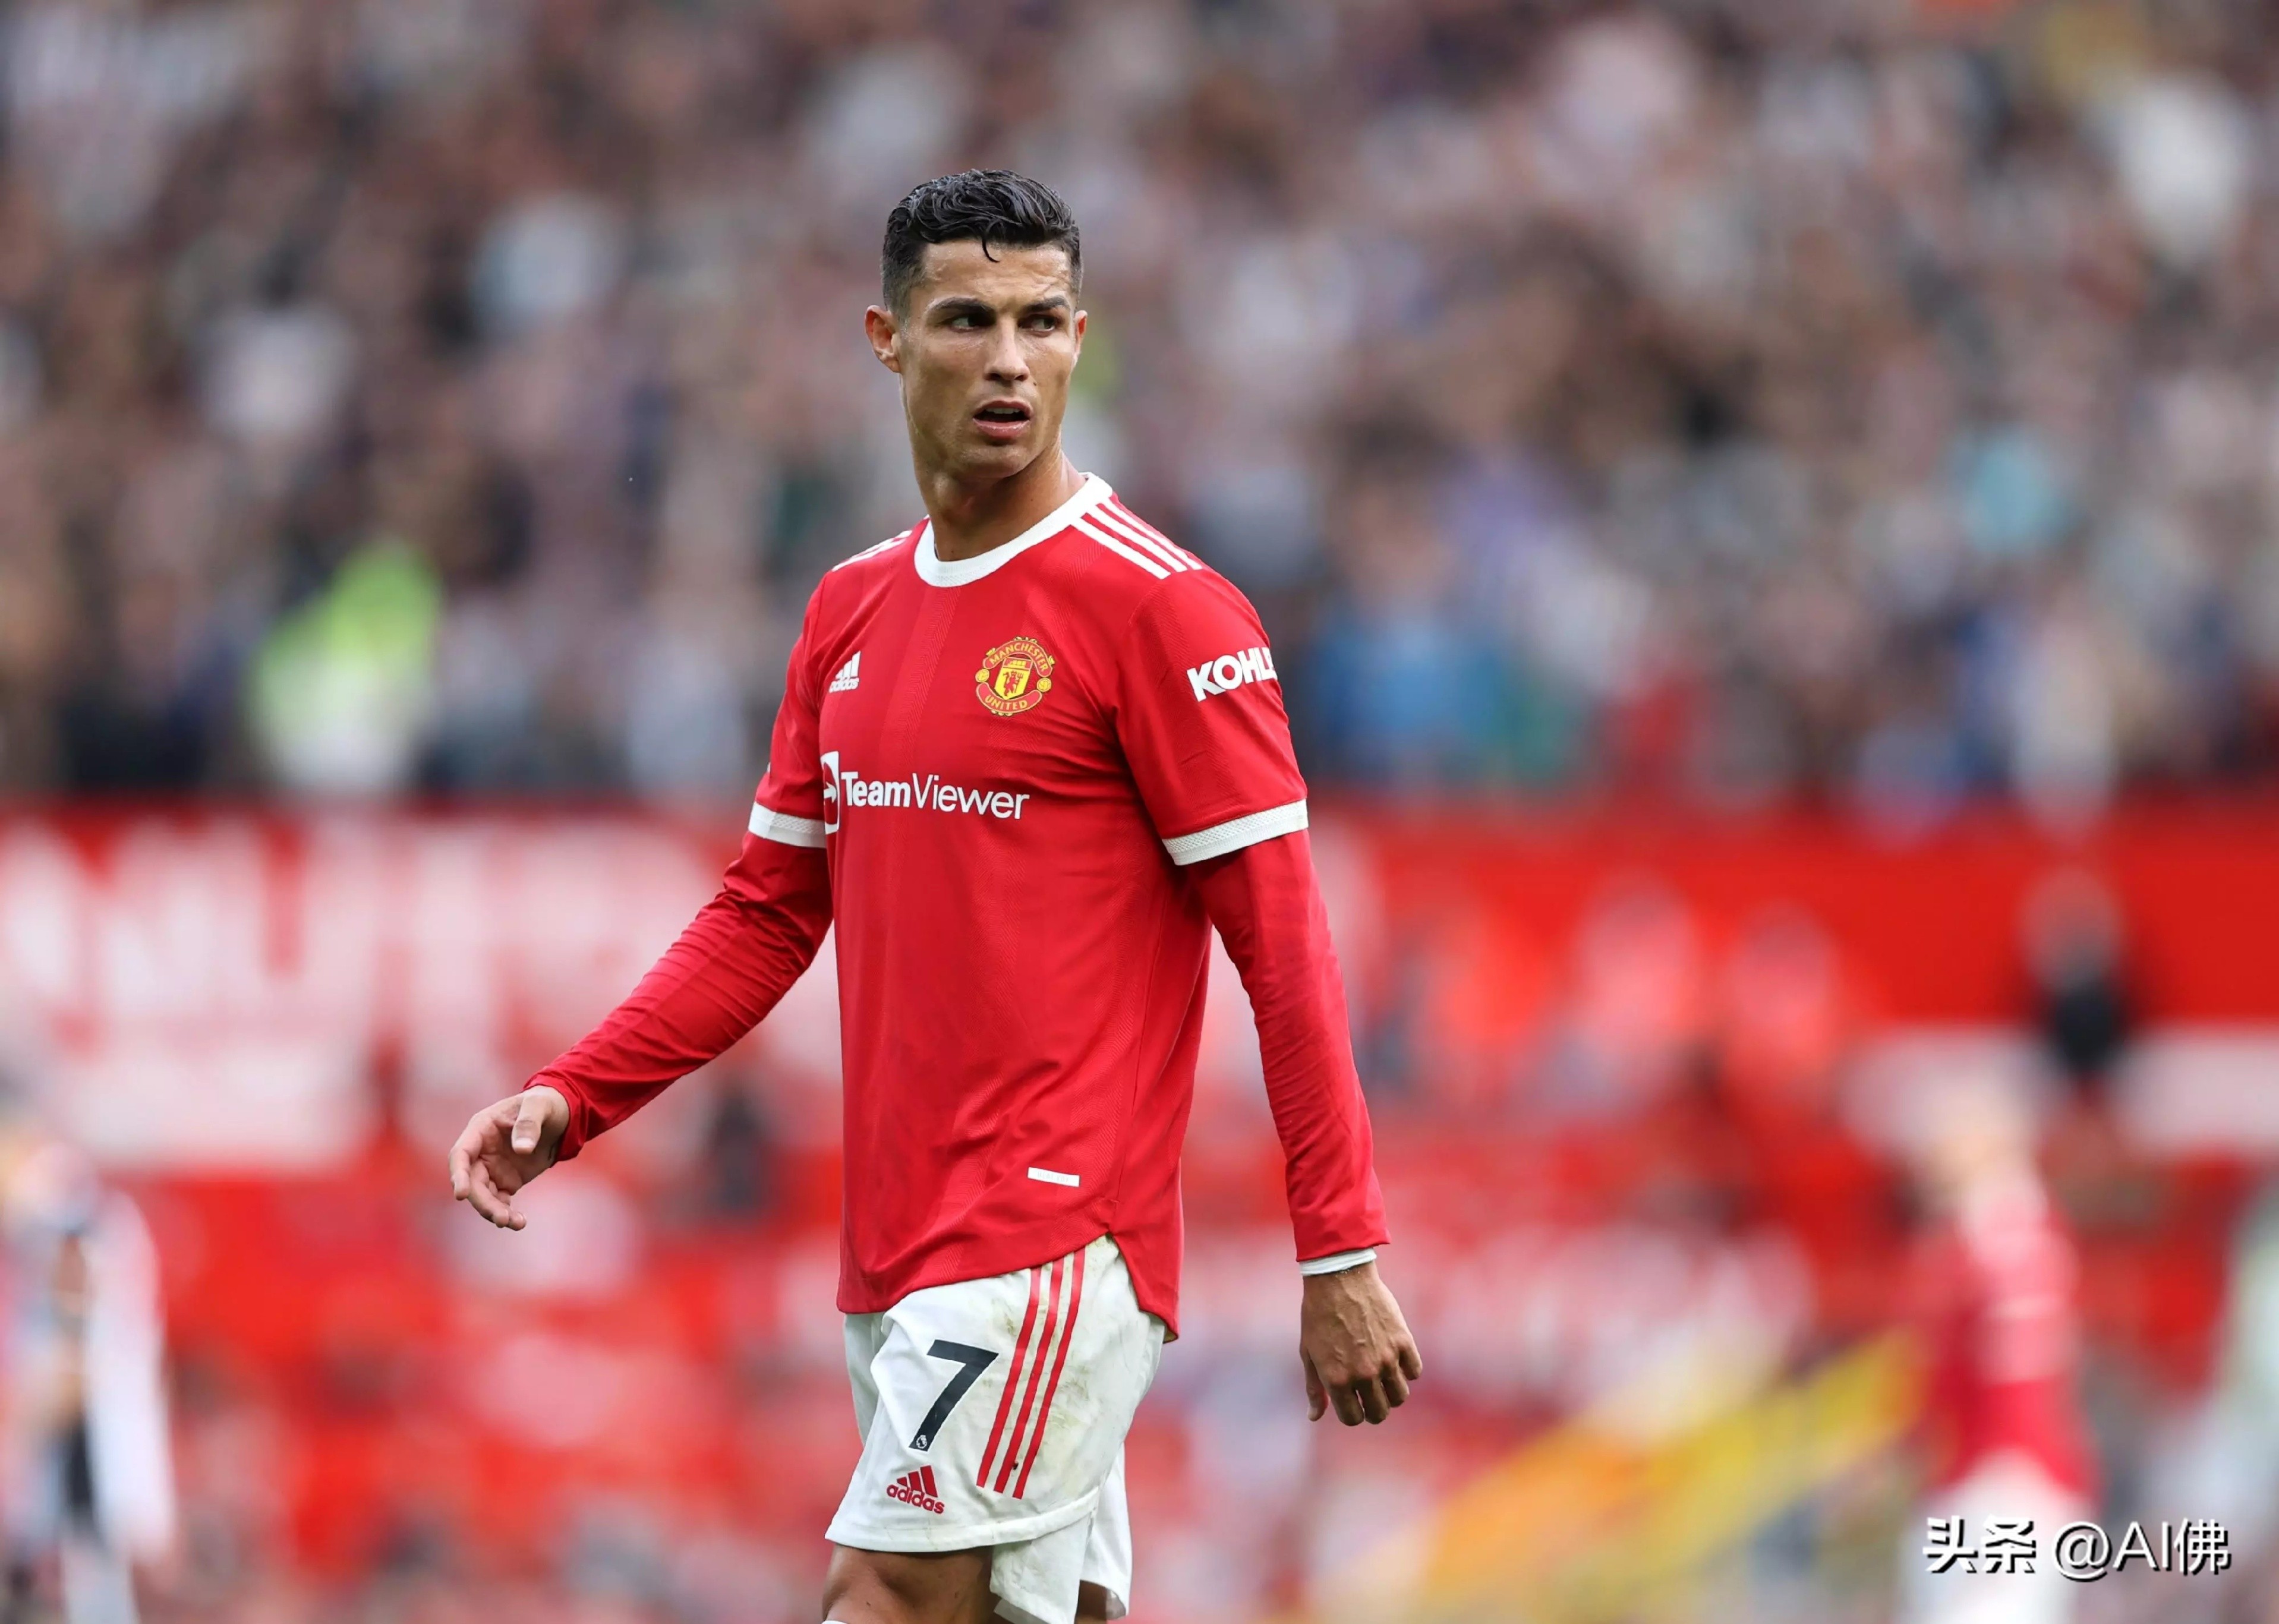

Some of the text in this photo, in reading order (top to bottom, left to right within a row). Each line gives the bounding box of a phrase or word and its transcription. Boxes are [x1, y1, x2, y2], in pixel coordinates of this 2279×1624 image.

[989, 643, 1048, 671] MANCHESTER
[985, 695, 1027, 710] UNITED
[841, 772, 1030, 819] TeamViewer
[909, 1339, 999, 1451] 7
[886, 1484, 945, 1514] adidas
